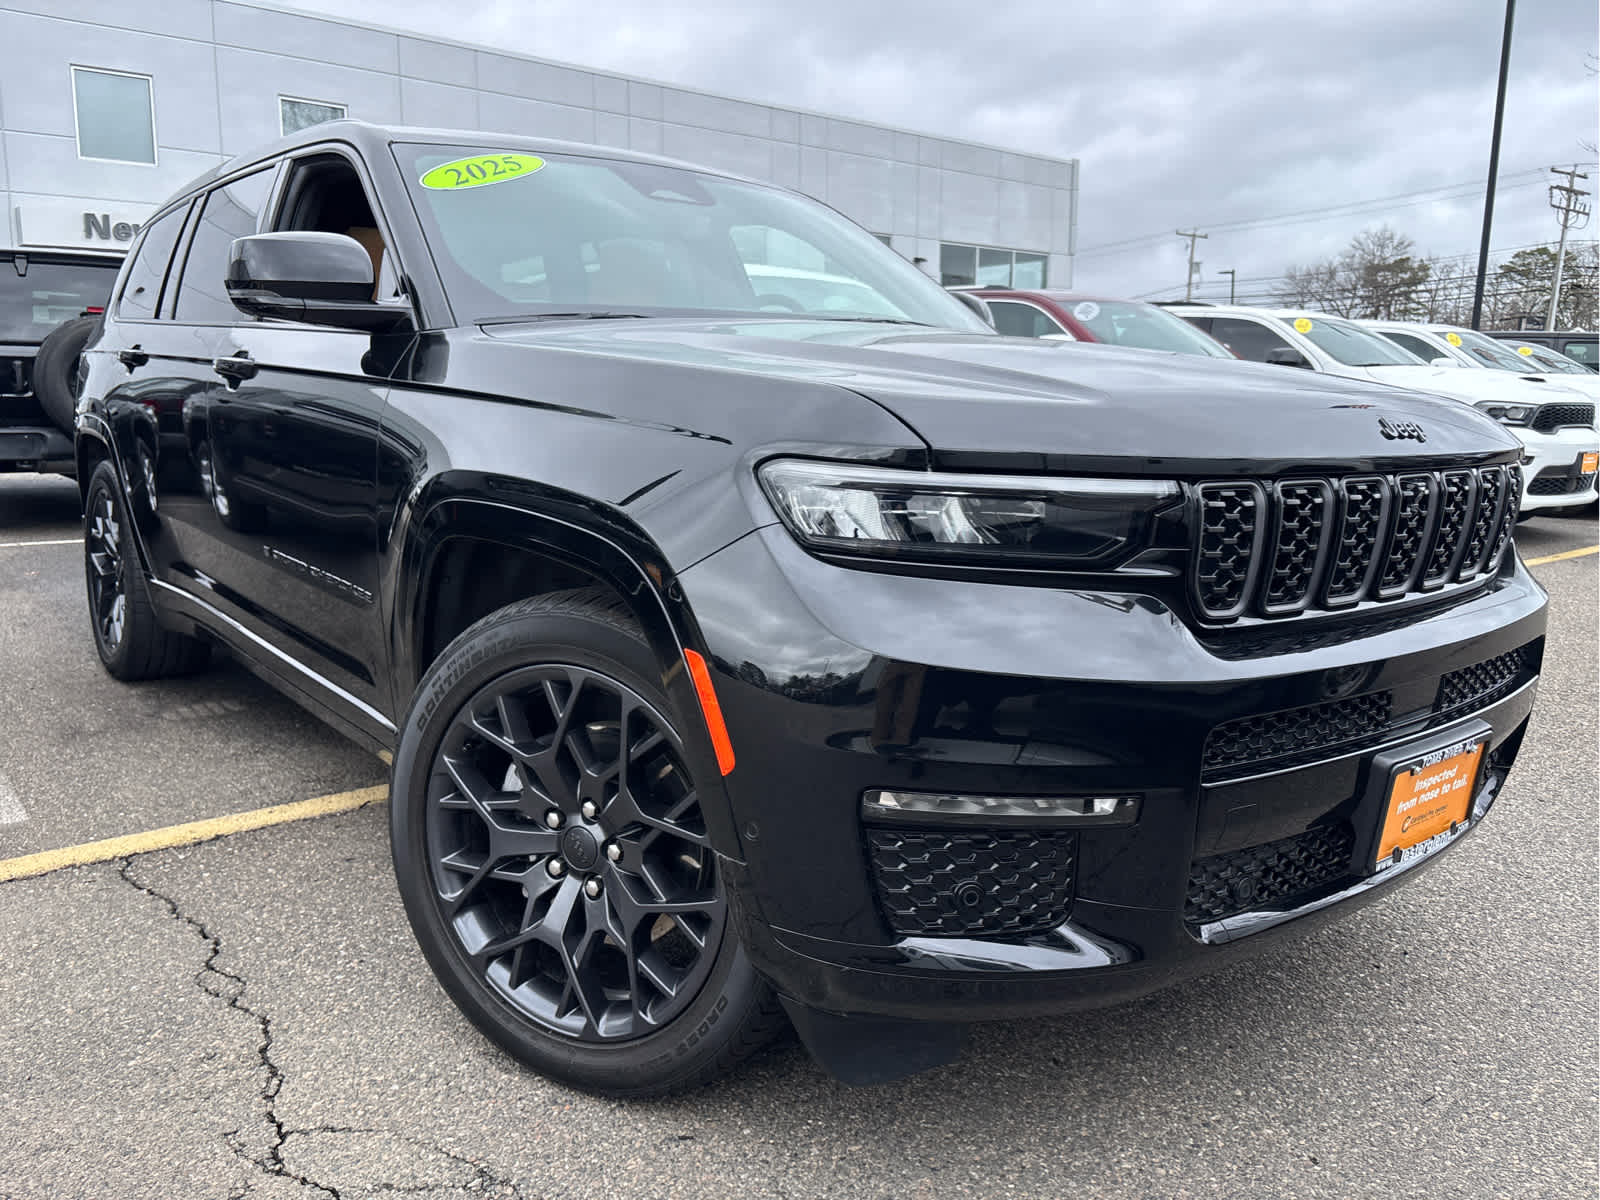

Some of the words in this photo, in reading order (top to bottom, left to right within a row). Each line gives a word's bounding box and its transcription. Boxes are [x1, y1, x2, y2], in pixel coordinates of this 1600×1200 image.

[444, 156, 522, 185] 2025
[1378, 416, 1427, 444] Jeep
[1414, 764, 1458, 792] Inspected
[1396, 797, 1418, 815] from
[1418, 788, 1440, 805] nose
[1441, 783, 1451, 795] to
